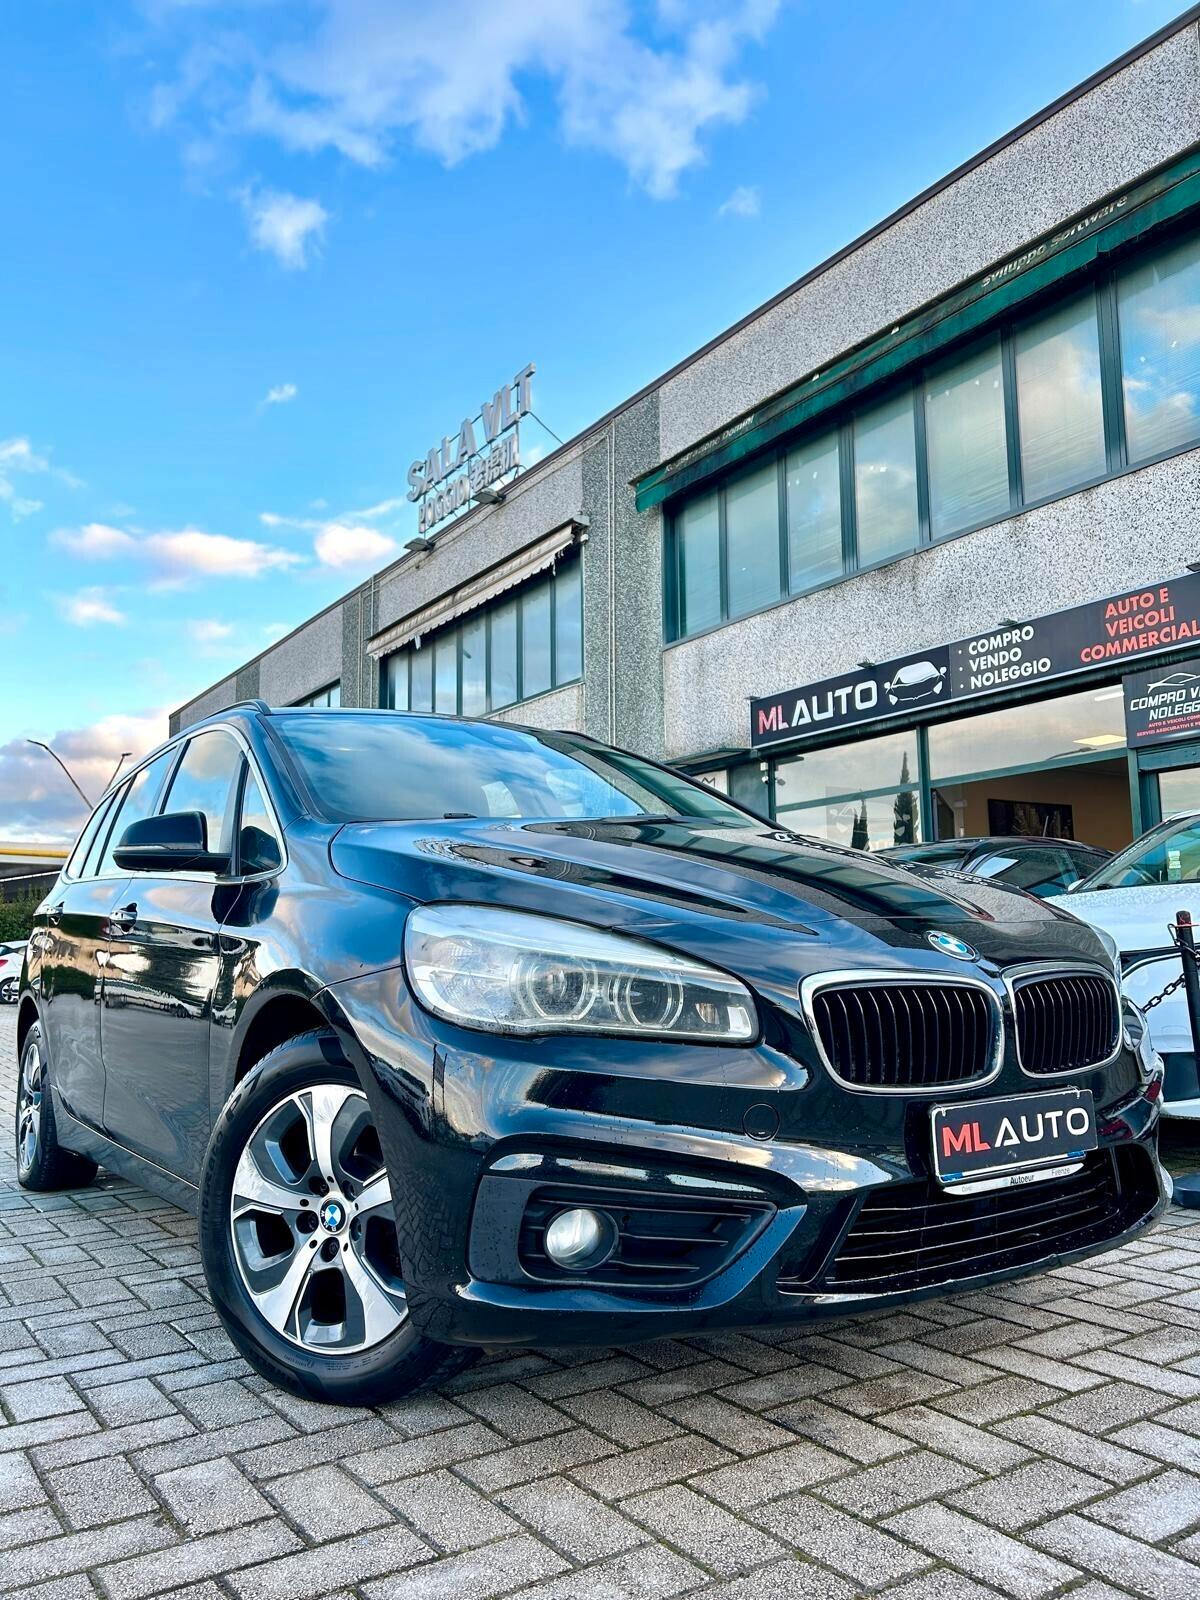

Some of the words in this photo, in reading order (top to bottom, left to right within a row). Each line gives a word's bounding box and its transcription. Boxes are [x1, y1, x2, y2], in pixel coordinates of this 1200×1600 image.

[407, 418, 477, 502] SALA
[481, 362, 536, 443] VLT
[1105, 592, 1155, 619] AUTO
[1160, 587, 1169, 604] E
[1105, 606, 1175, 637] VEICOLI
[968, 625, 1034, 655] COMPRO
[968, 647, 1022, 672] VENDO
[970, 657, 1051, 690] NOLEGGIO
[1130, 689, 1186, 711] COMPRO
[1190, 686, 1200, 699] V
[1009, 1174, 1035, 1186] Autoeur
[1051, 1167, 1071, 1177] Firenze
